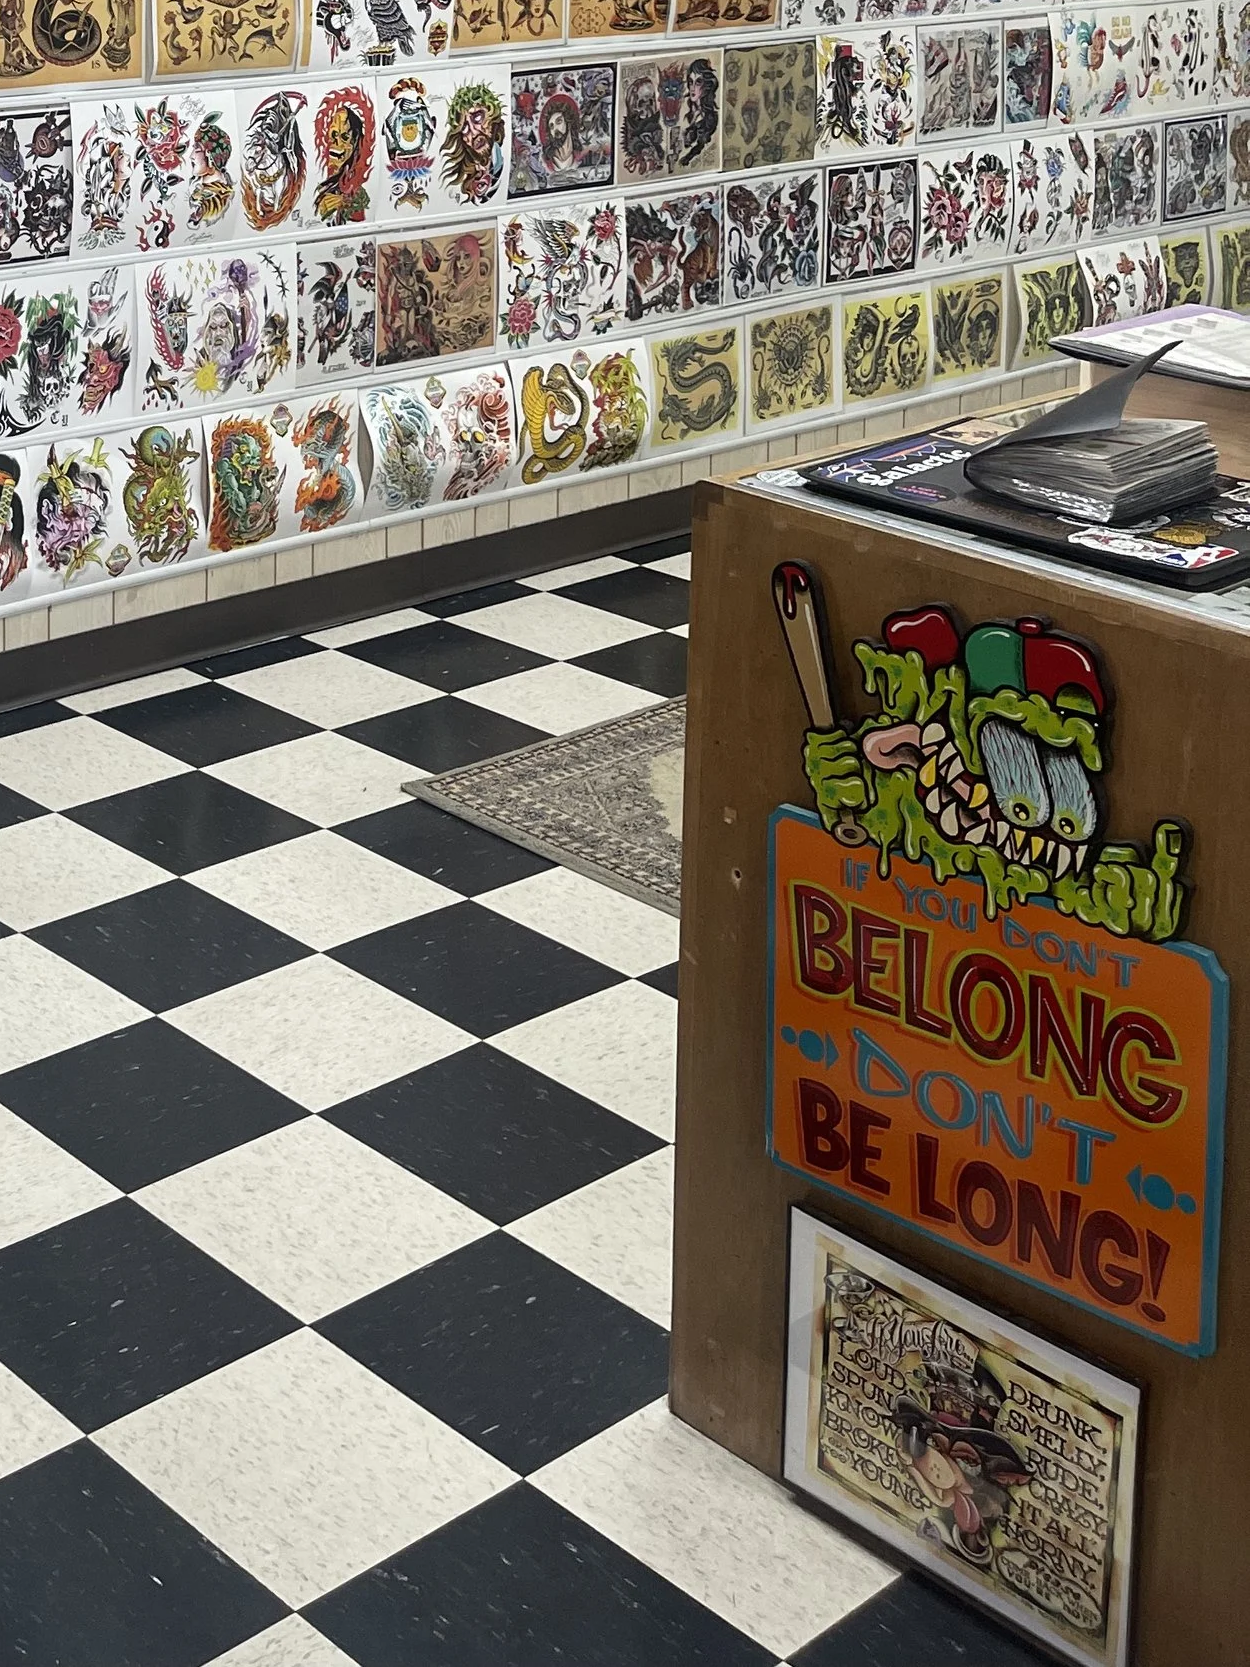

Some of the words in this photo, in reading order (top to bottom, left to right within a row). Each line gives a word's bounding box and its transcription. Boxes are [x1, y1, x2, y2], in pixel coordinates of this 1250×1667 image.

[855, 449, 973, 487] galactic
[845, 857, 868, 892] IF
[900, 874, 977, 934] YOU
[1002, 914, 1141, 989] DON'T
[789, 879, 1190, 1130] BELONG
[852, 1027, 1116, 1186] DON'T
[798, 1076, 893, 1197] BE
[914, 1131, 1171, 1322] LONG!
[1007, 1379, 1108, 1455] DRUNK,
[1025, 1445, 1105, 1511] RUDE,
